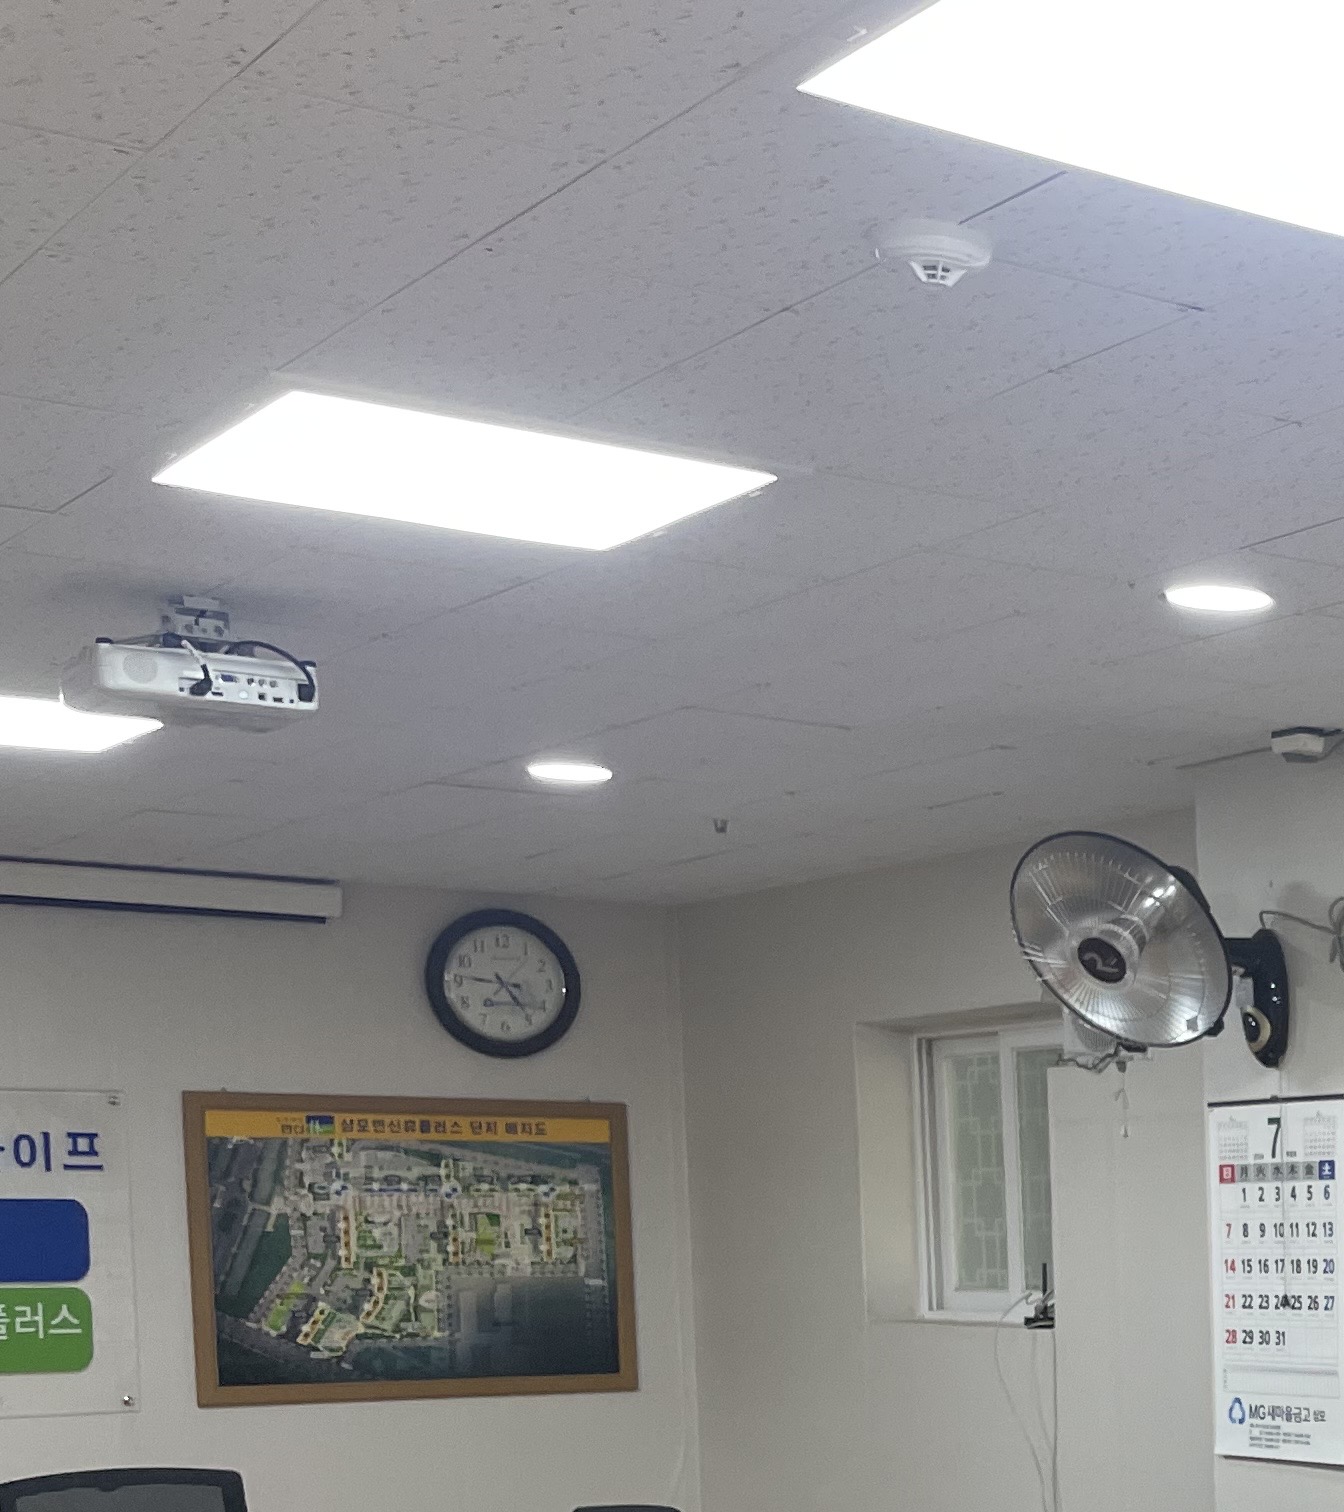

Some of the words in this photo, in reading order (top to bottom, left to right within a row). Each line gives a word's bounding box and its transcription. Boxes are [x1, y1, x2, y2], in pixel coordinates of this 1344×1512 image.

[496, 934, 510, 948] 12
[1267, 1117, 1281, 1159] 7
[1321, 1162, 1332, 1175] 土
[1273, 1222, 1284, 1238] 10
[1289, 1222, 1300, 1238] 11
[1306, 1222, 1318, 1238] 12
[1322, 1221, 1334, 1238] 13
[1224, 1259, 1236, 1273] 14
[1241, 1259, 1253, 1274] 15
[1258, 1259, 1270, 1274] 16
[1274, 1259, 1285, 1274] 17
[1290, 1258, 1302, 1274] 18
[1307, 1258, 1318, 1274] 19
[1323, 1258, 1335, 1274] 20
[1224, 1293, 1236, 1309] 21
[1241, 1294, 1254, 1310] 22
[1258, 1294, 1270, 1310] 23
[1274, 1294, 1288, 1310] 24
[1291, 1295, 1303, 1311] 25
[1307, 1295, 1320, 1311] 26
[1324, 1295, 1335, 1311] 27
[1225, 1329, 1238, 1344] 28
[1242, 1329, 1254, 1345] 29
[1258, 1330, 1271, 1345] 30
[1275, 1330, 1286, 1346] 31
